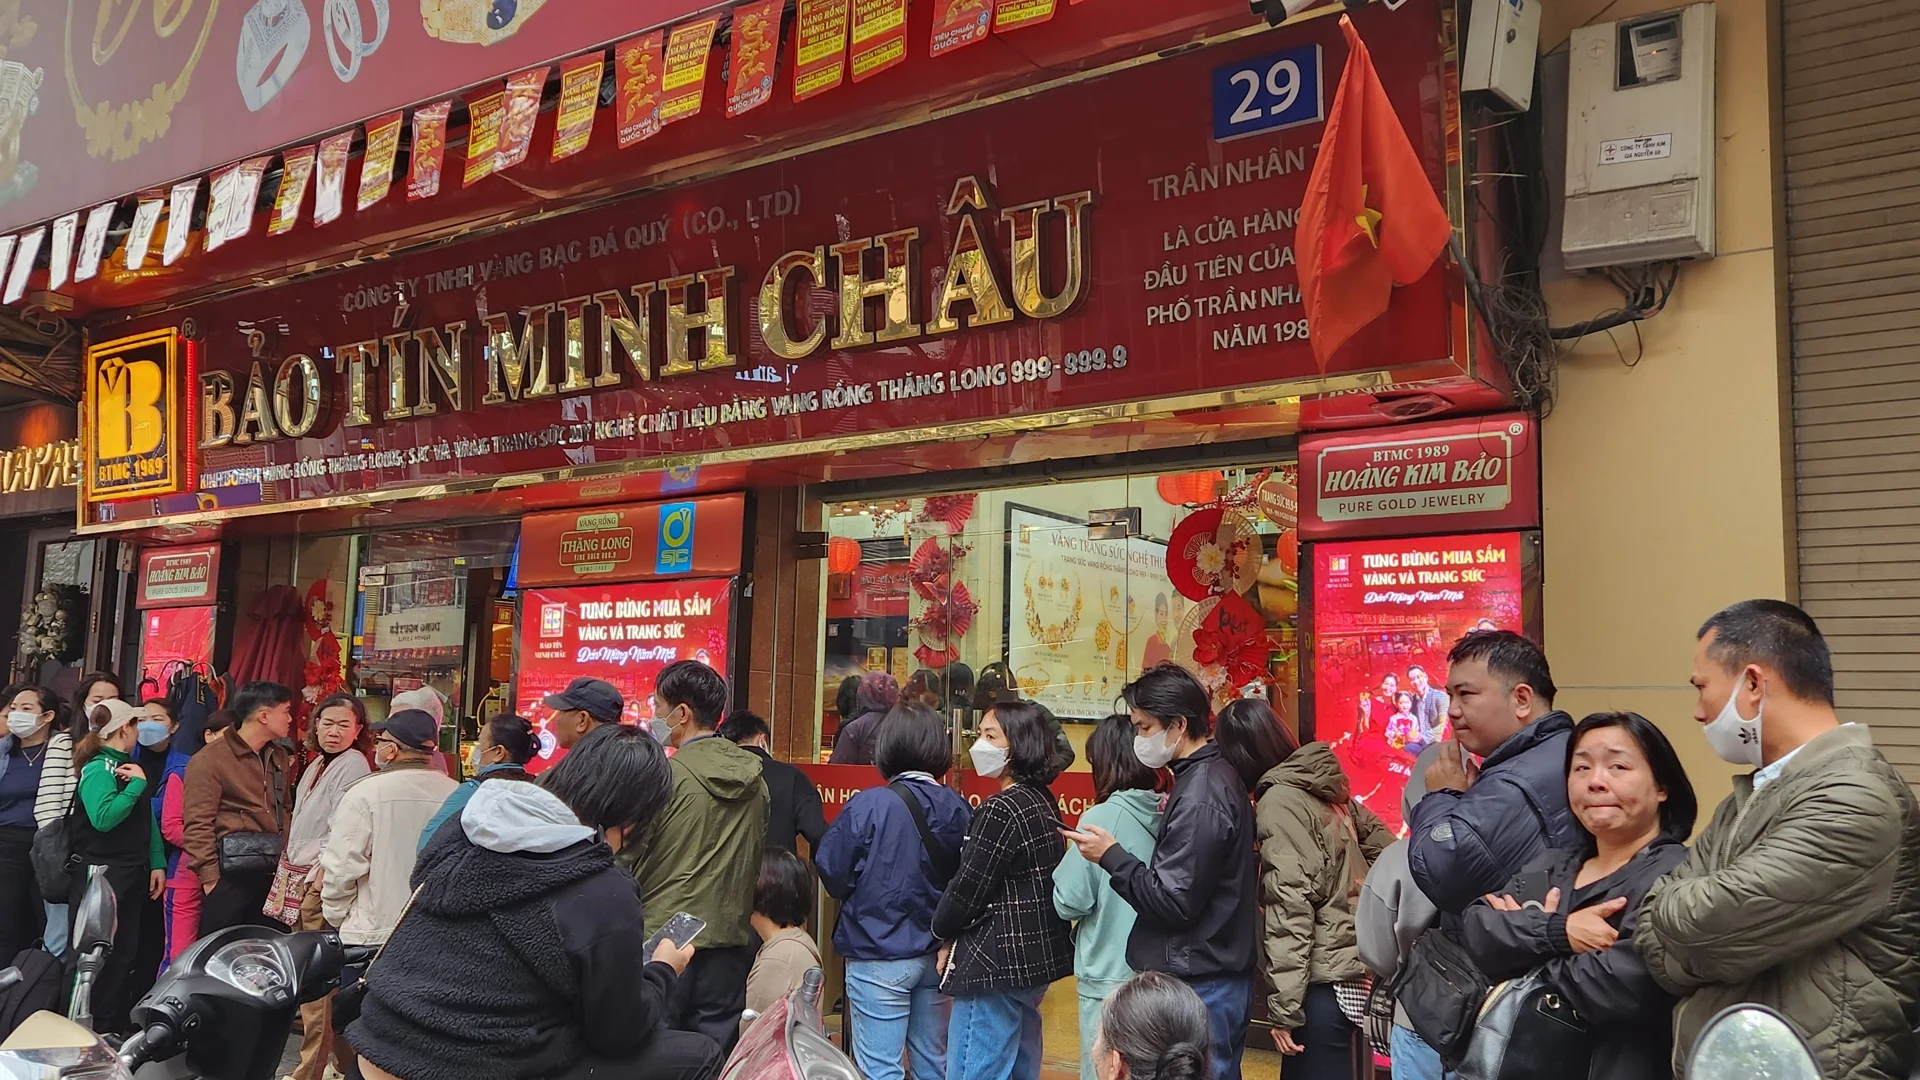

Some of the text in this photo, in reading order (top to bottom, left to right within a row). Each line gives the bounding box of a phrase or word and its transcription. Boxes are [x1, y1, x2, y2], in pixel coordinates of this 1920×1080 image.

[826, 16, 844, 29] LONG
[934, 23, 975, 42] TIÊU CHUẨN
[933, 30, 973, 50] QUỐC TẾ
[688, 47, 706, 59] LONG
[729, 86, 760, 104] TIÊU CHUẨN
[1230, 59, 1301, 124] 29
[728, 100, 748, 112] QUỐC
[620, 124, 632, 135] TIÊU
[620, 130, 641, 143] QUỐC
[1148, 148, 1306, 202] TRẦN NHÂN
[1163, 224, 1190, 252] LÀ
[1194, 215, 1237, 246] CỬA
[343, 282, 392, 313] CÔNG
[425, 266, 474, 295] TNHH
[479, 249, 533, 281] VÀNG
[539, 239, 581, 272] BẠC
[588, 228, 617, 257] ĐÁ
[625, 214, 671, 248] QUÝ
[744, 184, 800, 224] LTD)
[1143, 243, 1295, 290] ĐẦU TIÊN CỦA
[199, 175, 1091, 449] BẢO TÍN MINH CHÂU
[1146, 297, 1192, 326] PHỐ
[1194, 286, 1257, 319] TRẦN
[1212, 318, 1310, 351] NĂM 198
[294, 455, 326, 478] RỒNG
[491, 430, 538, 454] TRANG
[569, 420, 592, 444] MỸ
[595, 412, 635, 441] NGHỆ
[638, 404, 679, 434] CHẤT
[682, 394, 719, 432] LIỆU
[719, 391, 767, 424] BẰNG
[771, 385, 820, 416] VÀNG
[822, 379, 874, 411] RỒNG
[877, 368, 945, 402] THĂNG
[949, 362, 1007, 391] LONG
[1373, 445, 1450, 462] BTMC 1989
[99, 457, 163, 481] BTMC 1989
[1324, 452, 1502, 492] HOÀNG KIM BẢO
[1262, 490, 1276, 505] TRANG
[1339, 492, 1486, 514] PURE GOLD JEWELRY
[580, 514, 616, 527] VÀNG RỒNG
[562, 536, 630, 553] THĂNG LONG
[1051, 530, 1166, 569] VÀNG TRANG SỨC NGHỆ THU
[166, 558, 192, 567] BTMC 1989
[660, 548, 689, 568] SJC
[1401, 549, 1440, 568] BỪNG
[1442, 550, 1474, 565] MUA
[1476, 544, 1506, 564] SẮM
[148, 562, 206, 583] HOÀNG KIM BẢO
[1363, 566, 1486, 586] VÀNG VÀ TRANG SỨC
[165, 586, 178, 594] GOLD
[178, 586, 200, 594] JEWELRY
[1364, 592, 1386, 604] Đón
[1416, 590, 1442, 604] Năm
[615, 597, 651, 620] BỪNG
[654, 600, 682, 618] MUA
[683, 592, 712, 616] SẮM
[578, 620, 686, 641] VÀNG VÀ TRANG SỨC
[576, 646, 676, 666] Đón Mừng Năm Mới
[816, 782, 859, 804] ÂN HO
[961, 789, 981, 809] ÀO
[1058, 793, 1094, 816] ÁCH
